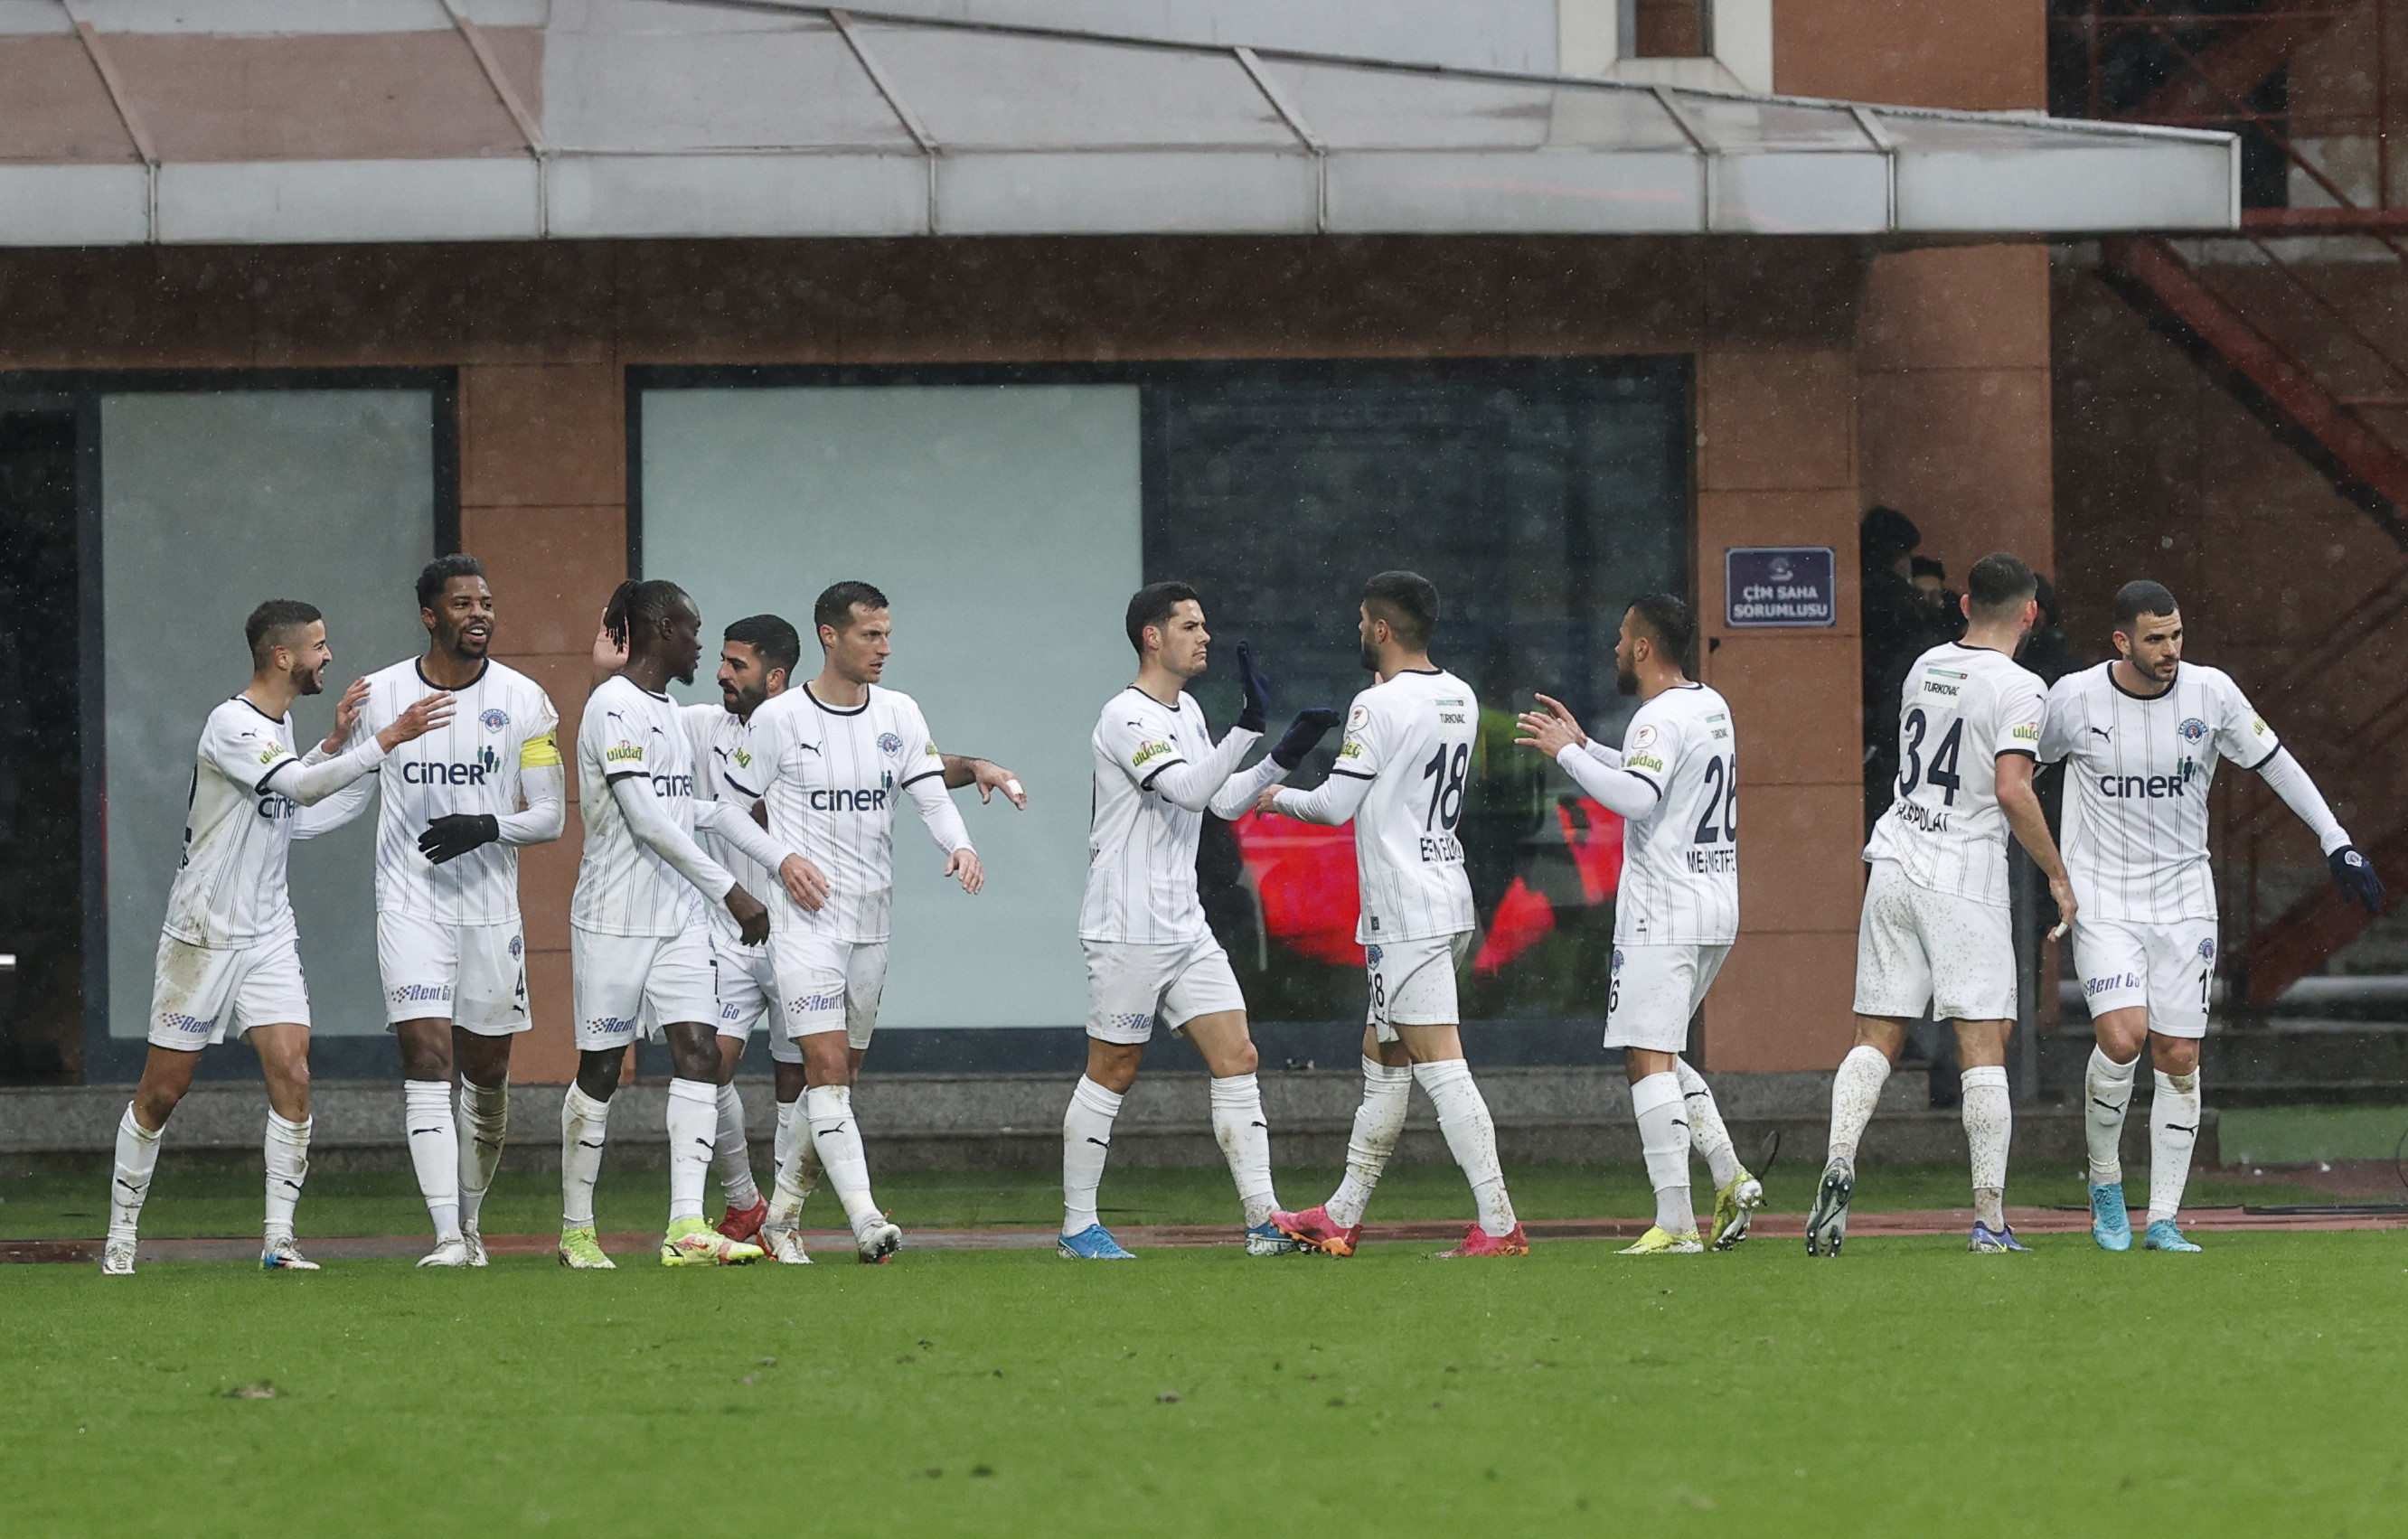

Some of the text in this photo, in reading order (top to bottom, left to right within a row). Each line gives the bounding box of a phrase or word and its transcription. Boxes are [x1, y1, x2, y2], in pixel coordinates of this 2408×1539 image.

[1743, 583, 1819, 603] ÇİM SAHA
[1734, 603, 1828, 618] SORUMLUSU
[1900, 709, 1963, 807] 34
[1424, 743, 1468, 831] 18
[409, 984, 441, 1000] Rent
[515, 966, 525, 1001] 4
[2089, 974, 2121, 997] Rent
[721, 1003, 739, 1019] Go
